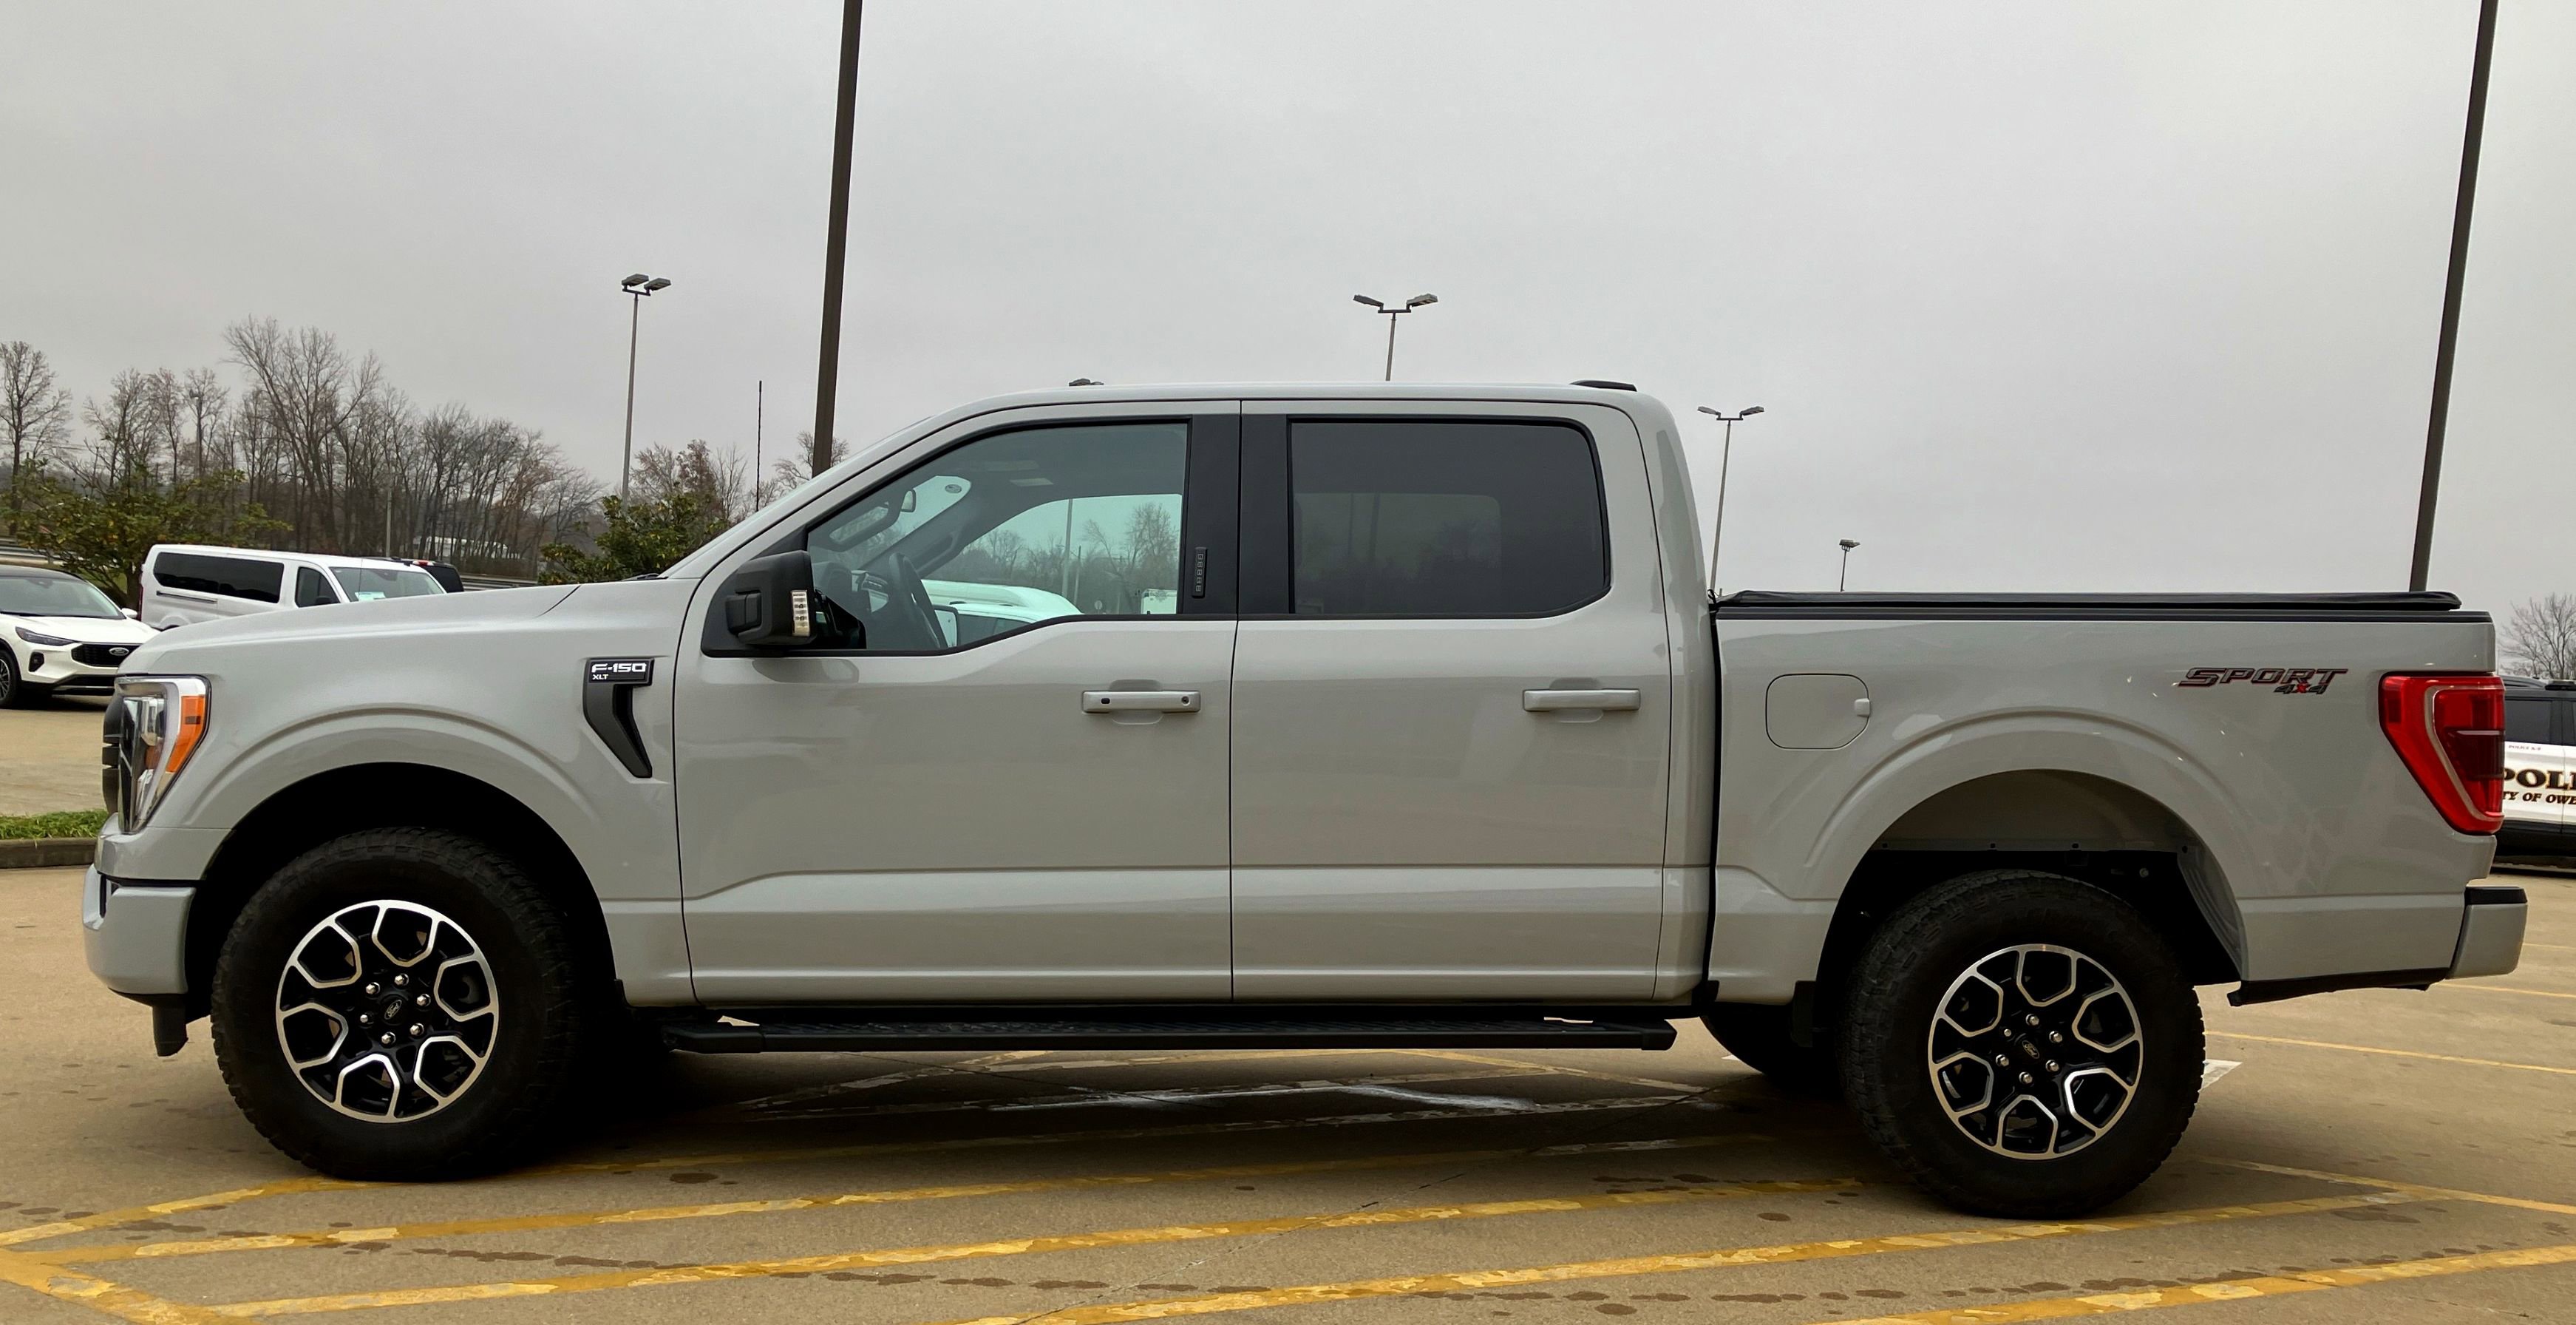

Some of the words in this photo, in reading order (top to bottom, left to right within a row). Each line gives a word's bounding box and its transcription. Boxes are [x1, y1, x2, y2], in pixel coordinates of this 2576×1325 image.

[591, 662, 647, 673] F-150
[2178, 667, 2348, 688] SPORT
[2522, 792, 2543, 802] OF
